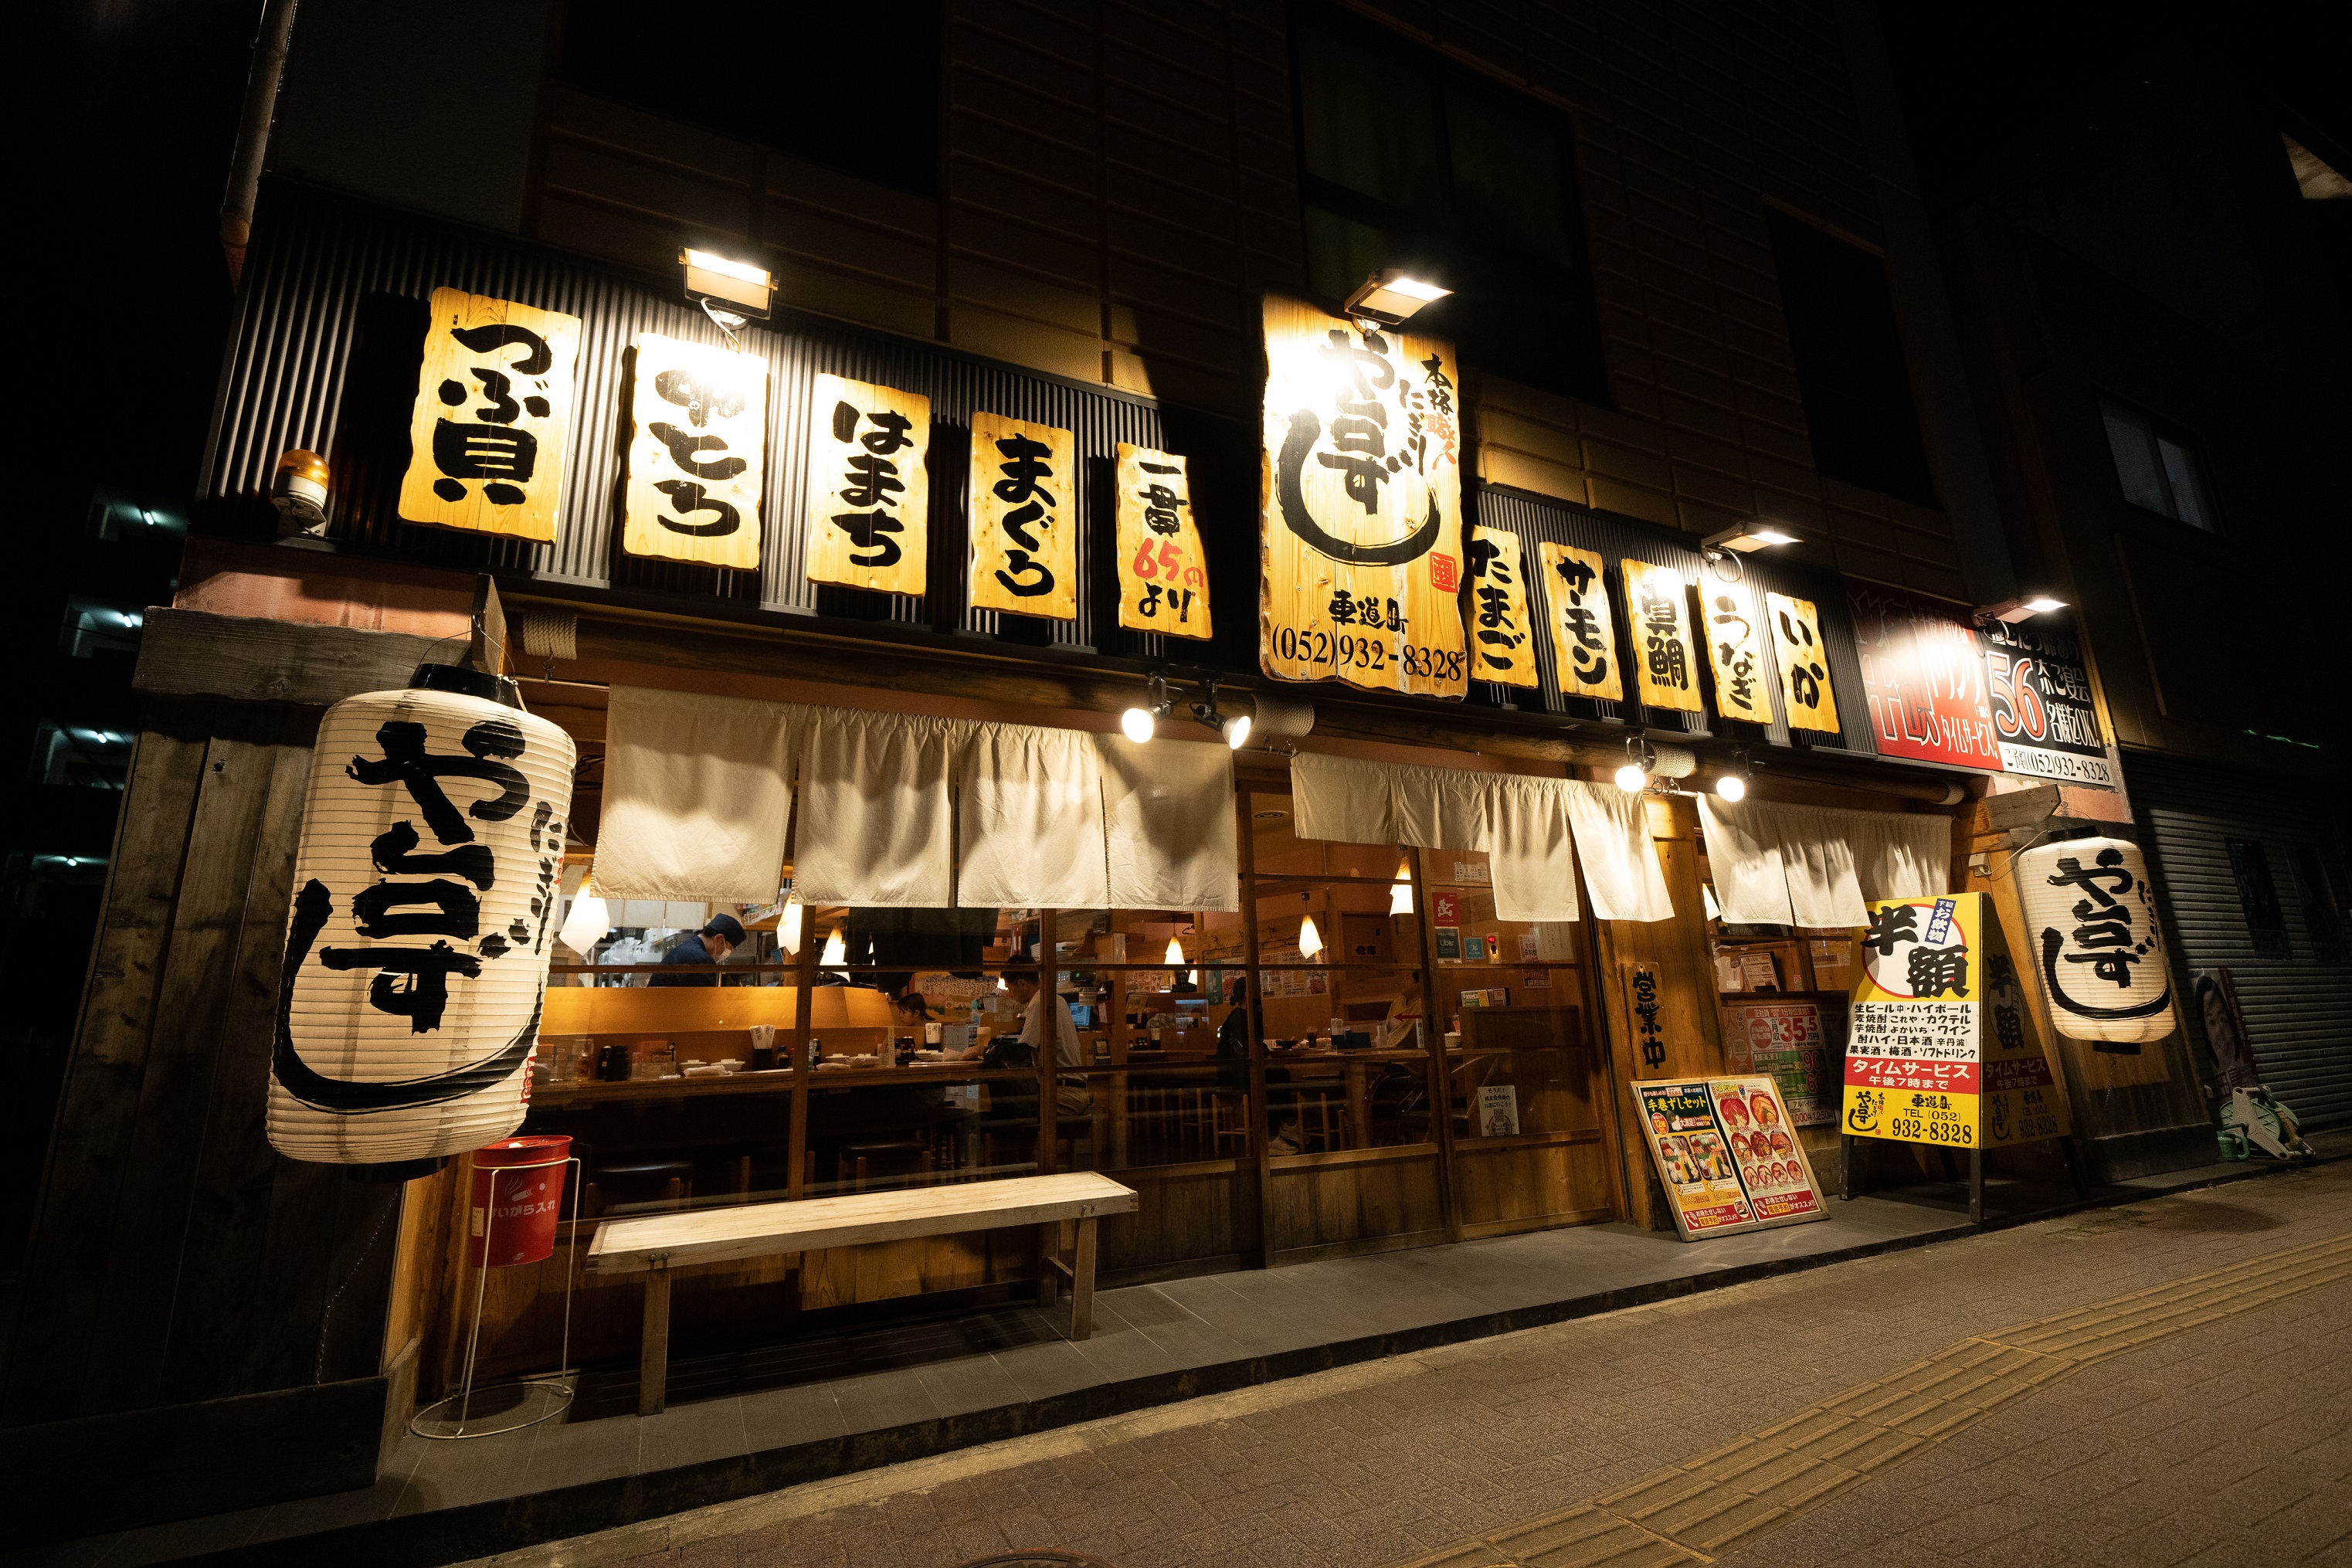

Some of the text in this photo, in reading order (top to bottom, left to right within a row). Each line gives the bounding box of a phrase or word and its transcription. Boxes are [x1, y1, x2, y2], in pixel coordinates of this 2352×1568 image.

[433, 324, 552, 505] つぶ貝
[830, 400, 915, 567] はまち
[992, 433, 1057, 597] まぐろ
[1138, 460, 1190, 538] 一貫
[1139, 582, 1192, 623] より
[1472, 538, 1526, 670] たまご
[1555, 555, 1607, 686] サーモン
[1641, 582, 1688, 691] 真鯛
[1271, 622, 1463, 683] (052)932-8328
[1712, 596, 1757, 711] うなぎ
[1780, 609, 1824, 710] いか
[1986, 650, 2047, 742] 56
[1860, 904, 1970, 999] 半額
[1927, 907, 1951, 942] お飲物
[1632, 971, 1666, 1070] 営業中
[1648, 1096, 1707, 1112] 手巻ずしセット
[1852, 1059, 1970, 1080] タイムサービス
[1868, 1076, 1949, 1090] 午後7時まで
[1985, 1057, 2046, 1079] タイムサービス
[1892, 1118, 1973, 1145] 932-8328
[1903, 1108, 1962, 1122] TEL (052)
[2018, 1115, 2058, 1140] 932-8328
[1764, 1194, 1798, 1205] お待たせしない
